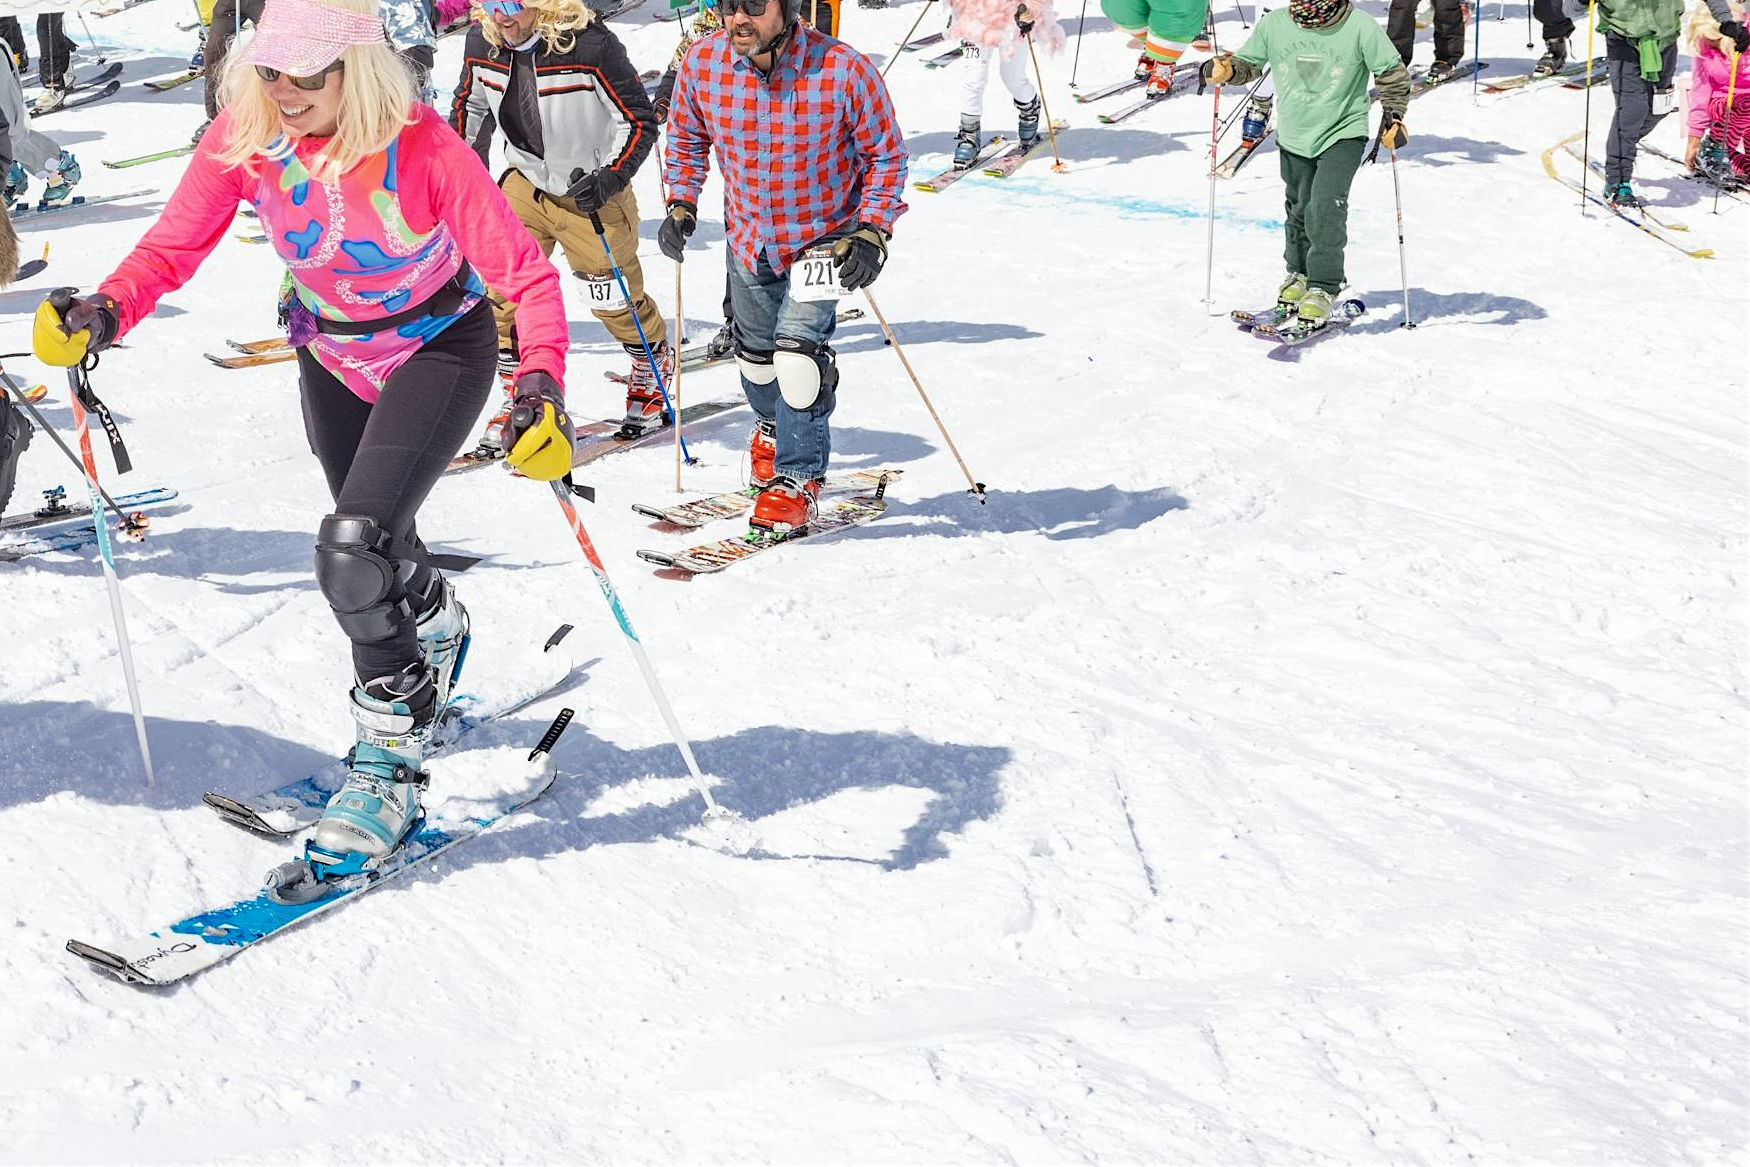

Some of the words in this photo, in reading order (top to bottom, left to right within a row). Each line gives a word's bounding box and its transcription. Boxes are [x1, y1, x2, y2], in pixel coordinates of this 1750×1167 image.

[965, 47, 980, 59] 273
[804, 260, 834, 287] 221
[588, 282, 611, 302] 137
